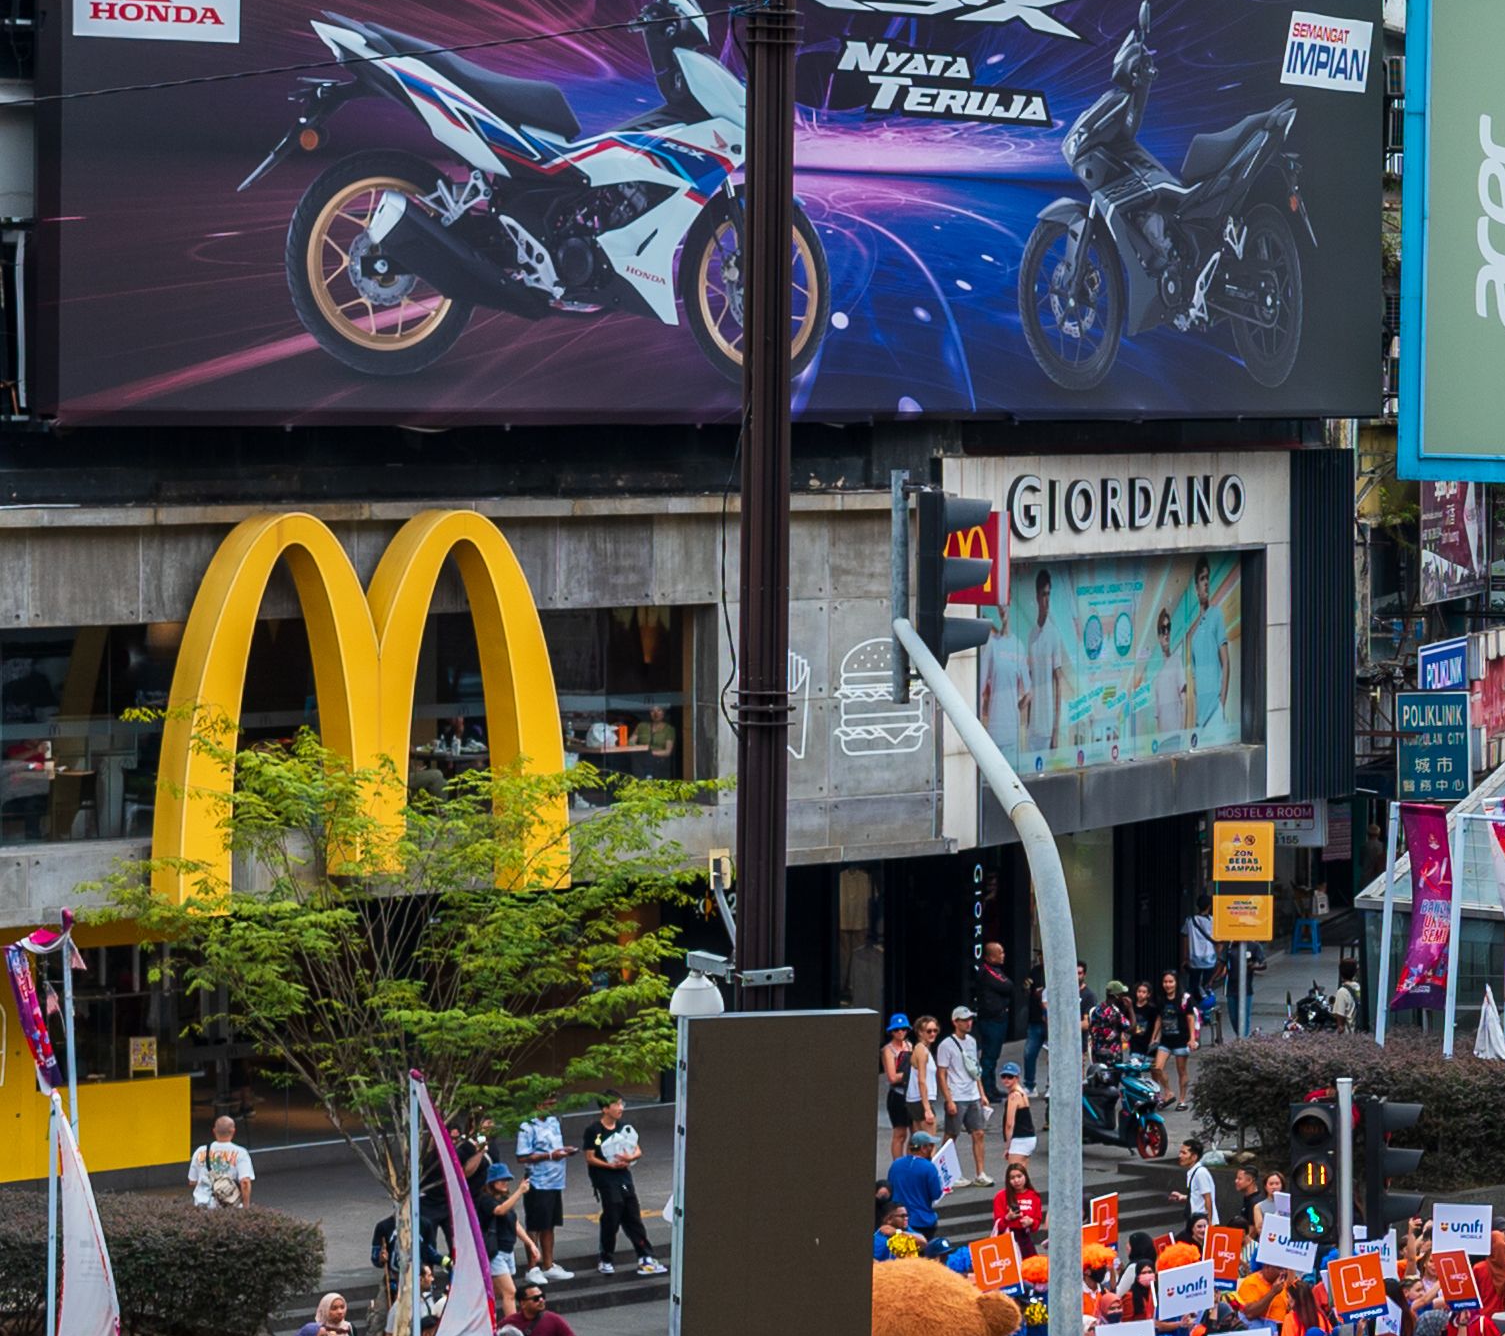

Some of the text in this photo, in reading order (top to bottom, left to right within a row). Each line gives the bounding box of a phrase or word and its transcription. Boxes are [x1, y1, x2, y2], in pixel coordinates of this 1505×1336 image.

[89, 1, 225, 26] HONDA
[1292, 21, 1350, 44] SEMANGAT
[1285, 41, 1367, 83] IMPIAN
[868, 75, 1049, 124] TERUJA
[626, 265, 666, 285] HONDA
[1007, 473, 1247, 540] GIORDANO
[1402, 705, 1463, 728] POLIKLINIK
[1447, 731, 1464, 746] CITY
[1414, 757, 1453, 773] 城市
[1216, 806, 1312, 818] HOSTEL & ROOM
[1420, 898, 1450, 915] BAND
[1307, 1162, 1326, 1185] 11
[1450, 1218, 1484, 1234] unifi
[1176, 1275, 1208, 1294] unifi
[1350, 1308, 1384, 1321] POSTPAID
